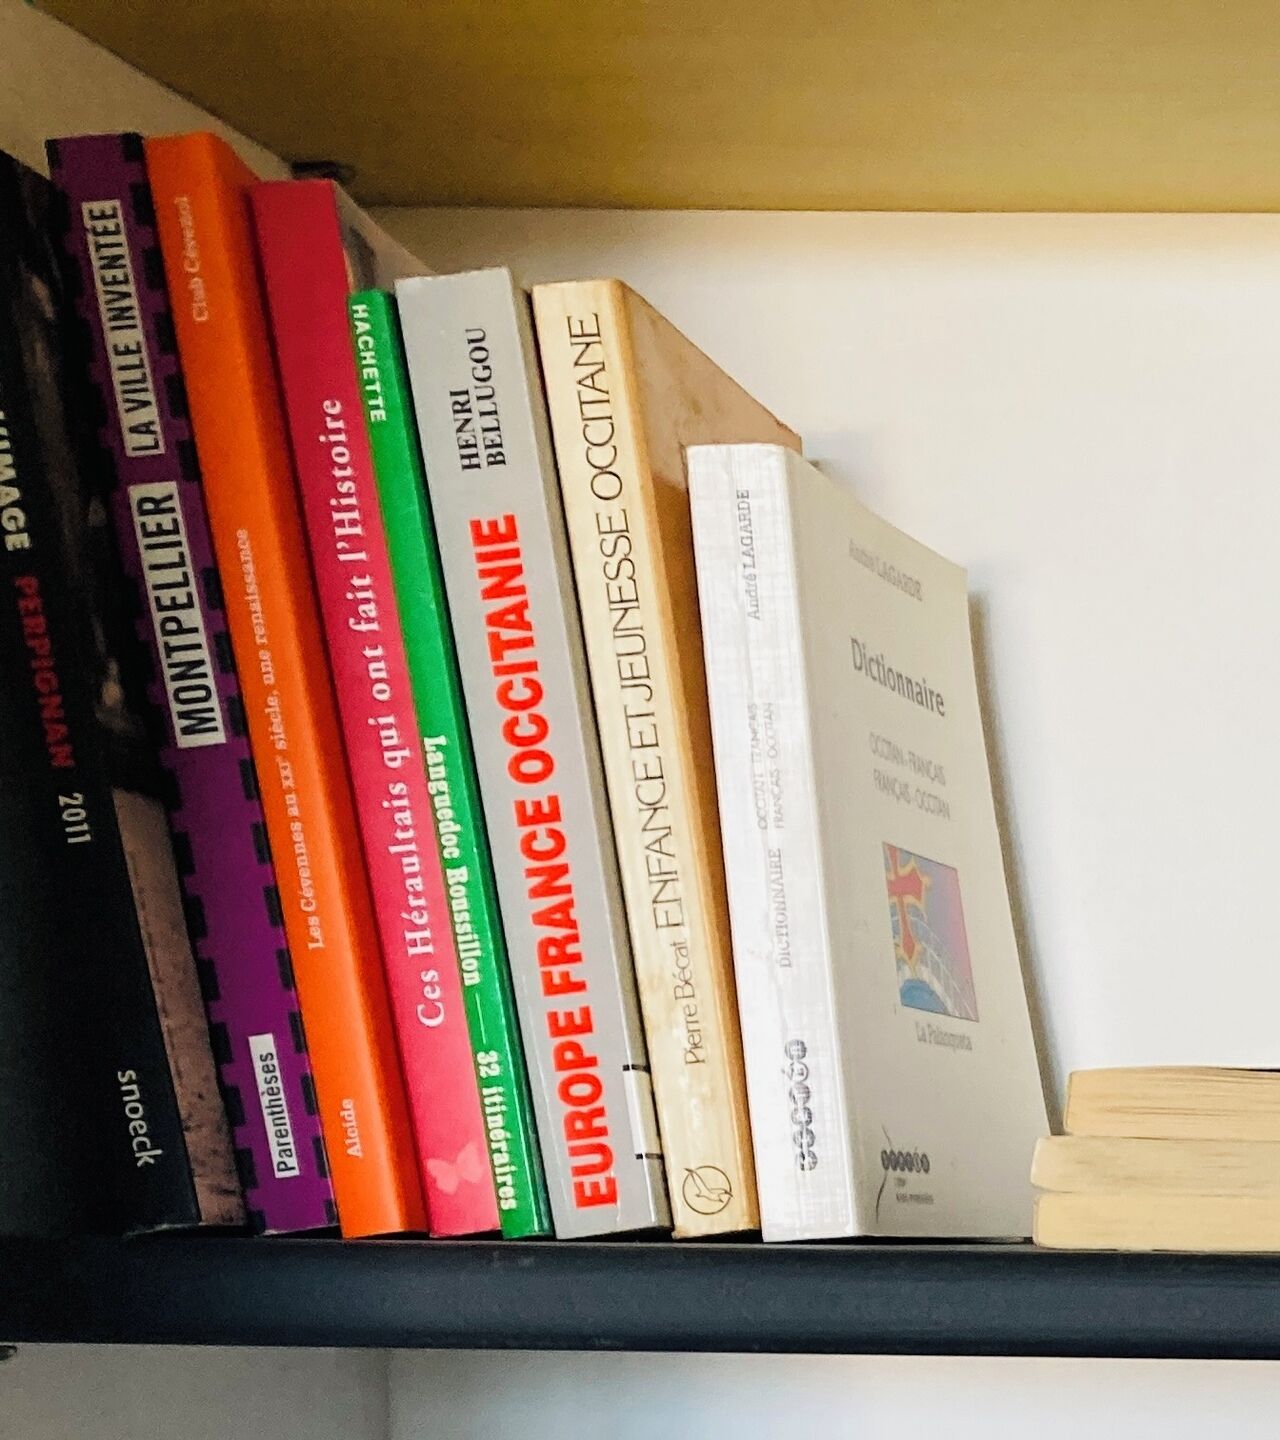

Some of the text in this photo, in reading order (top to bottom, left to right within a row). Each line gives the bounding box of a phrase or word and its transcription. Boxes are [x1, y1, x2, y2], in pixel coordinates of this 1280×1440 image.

[112, 338, 152, 413] VILLE
[351, 303, 386, 423] HACHETTE
[464, 327, 506, 467] BELLUGOU
[129, 421, 160, 451] LA
[449, 389, 482, 472] HENRI
[137, 494, 219, 736] MONTPELLIER
[236, 529, 271, 645] renaissance
[14, 575, 91, 845] PERPIGNAN 2011
[319, 400, 445, 1027] Ces Héraultais qui ont fait l'Histoire
[566, 312, 707, 1067] Pierre Bécat ENFANCE ET JEUNESSE OCCITANE
[849, 636, 946, 717] Dictionnaire
[284, 792, 300, 817] au
[423, 736, 480, 986] Languedoc Roussillon
[469, 514, 618, 1208] EUROPE FRANCE OCCITANIE
[289, 820, 319, 912] Cévennes
[768, 848, 792, 969] DICTIONNAIRE
[305, 914, 325, 950] Les
[117, 1068, 157, 1168] snoeck
[258, 1051, 296, 1174] Parenthèses
[340, 1098, 363, 1160] Alcide
[476, 1050, 517, 1212] 32 itinéraires
